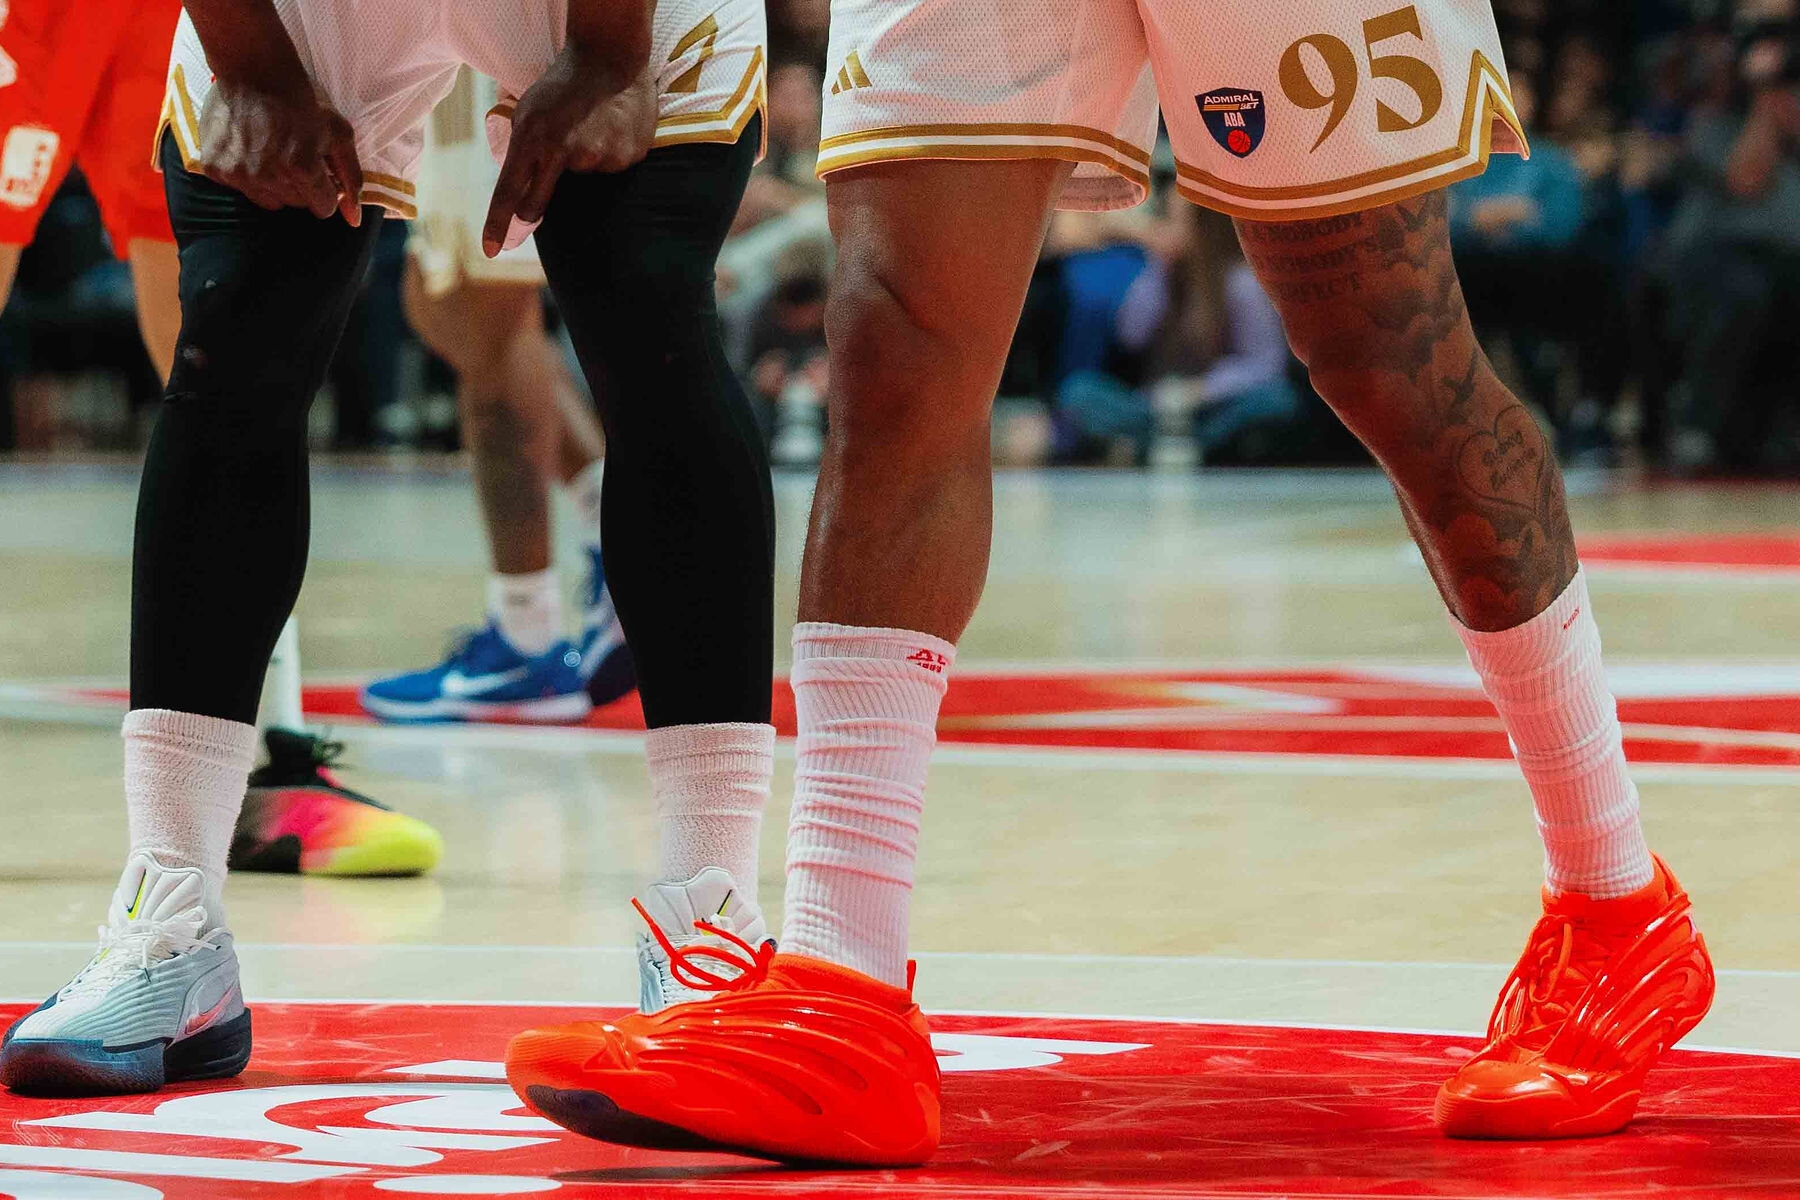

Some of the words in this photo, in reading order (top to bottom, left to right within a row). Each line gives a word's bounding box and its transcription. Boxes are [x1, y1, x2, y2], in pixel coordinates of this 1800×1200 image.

[1277, 5, 1443, 155] 95
[1204, 93, 1259, 105] ADMIRAL
[1224, 112, 1246, 127] ABA
